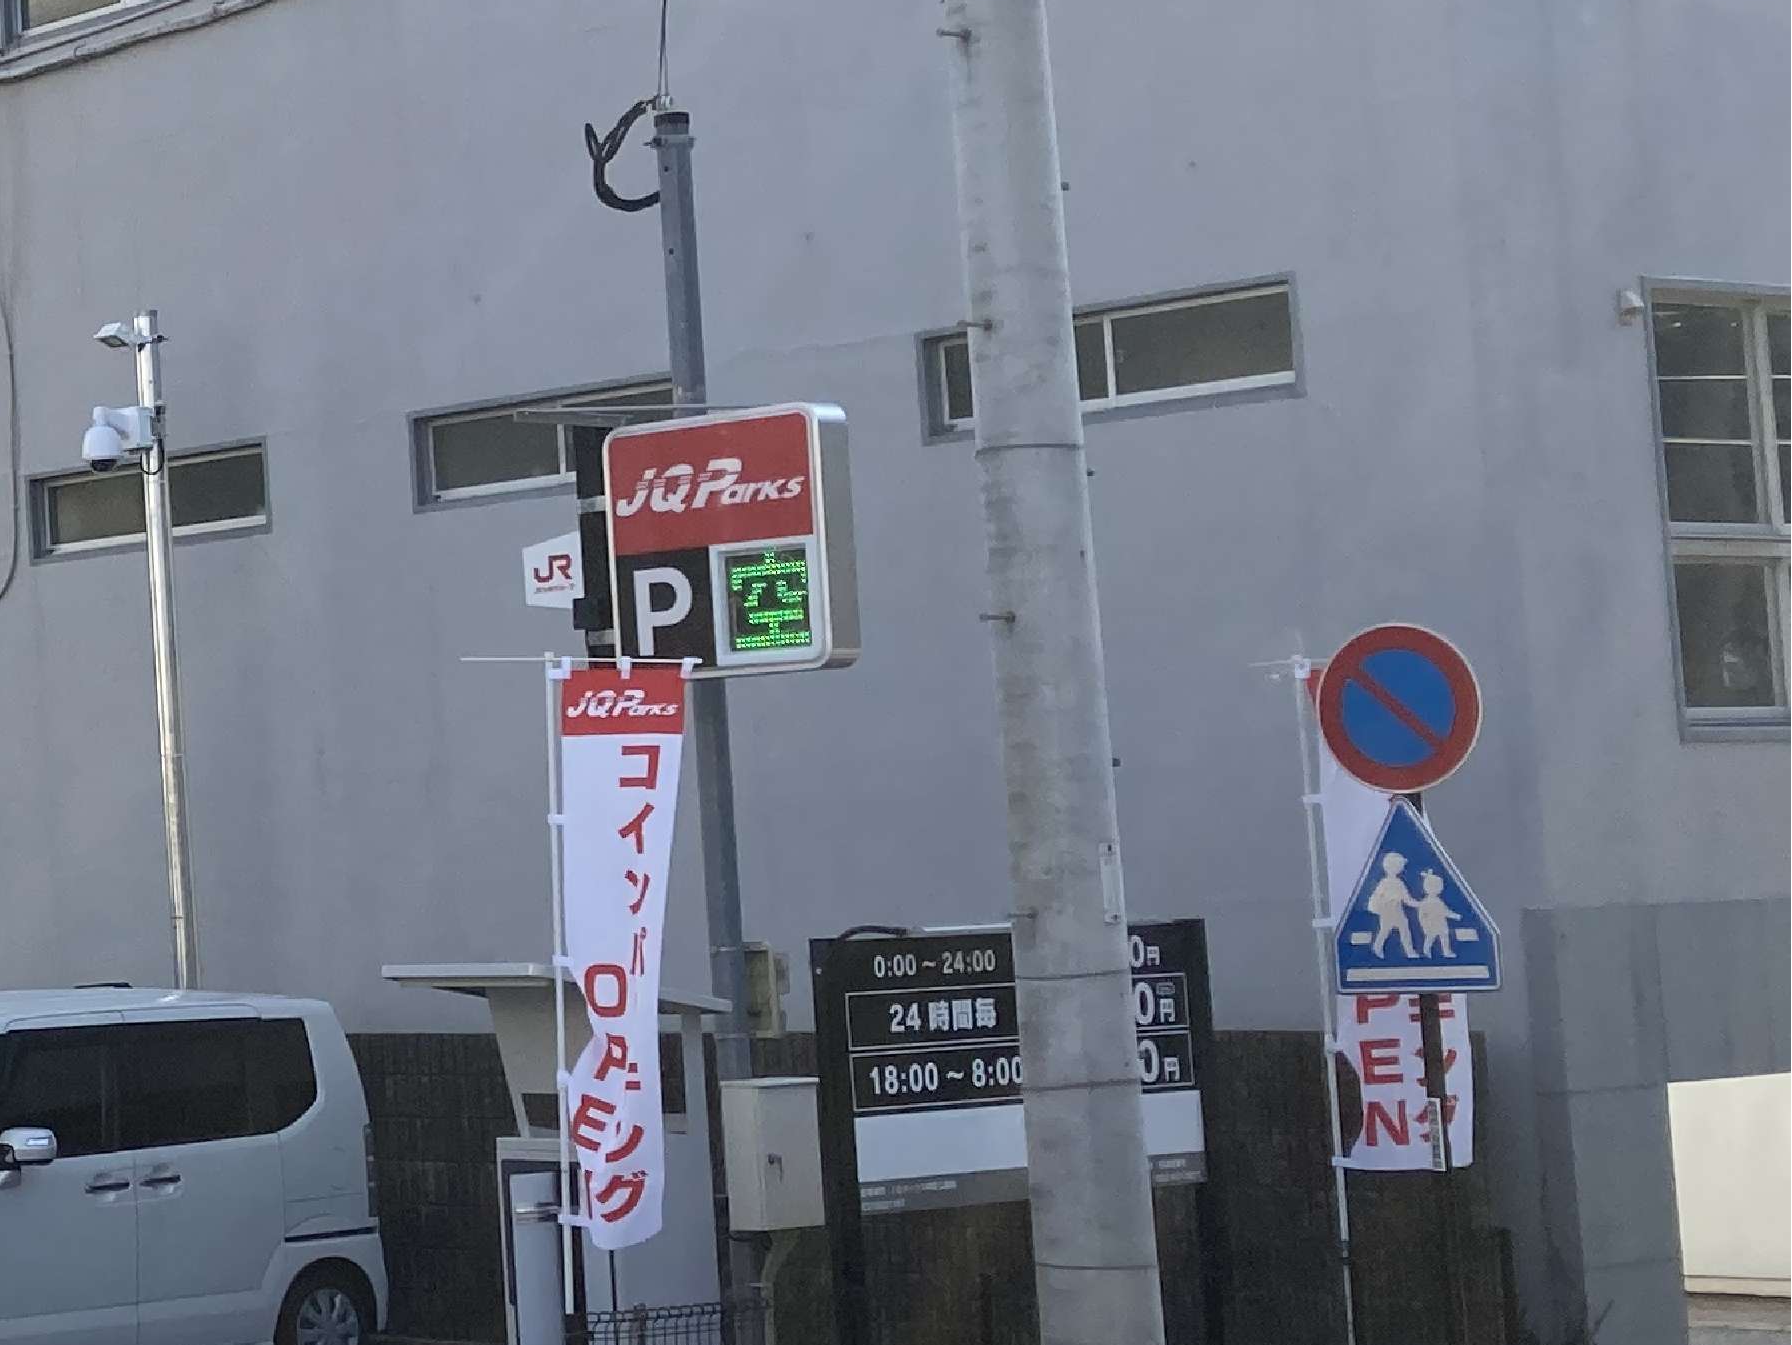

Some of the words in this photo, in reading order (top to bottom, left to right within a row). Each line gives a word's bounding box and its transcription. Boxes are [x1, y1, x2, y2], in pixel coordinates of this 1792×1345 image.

[533, 554, 573, 583] JR
[633, 567, 693, 657] P
[729, 549, 811, 649] 空
